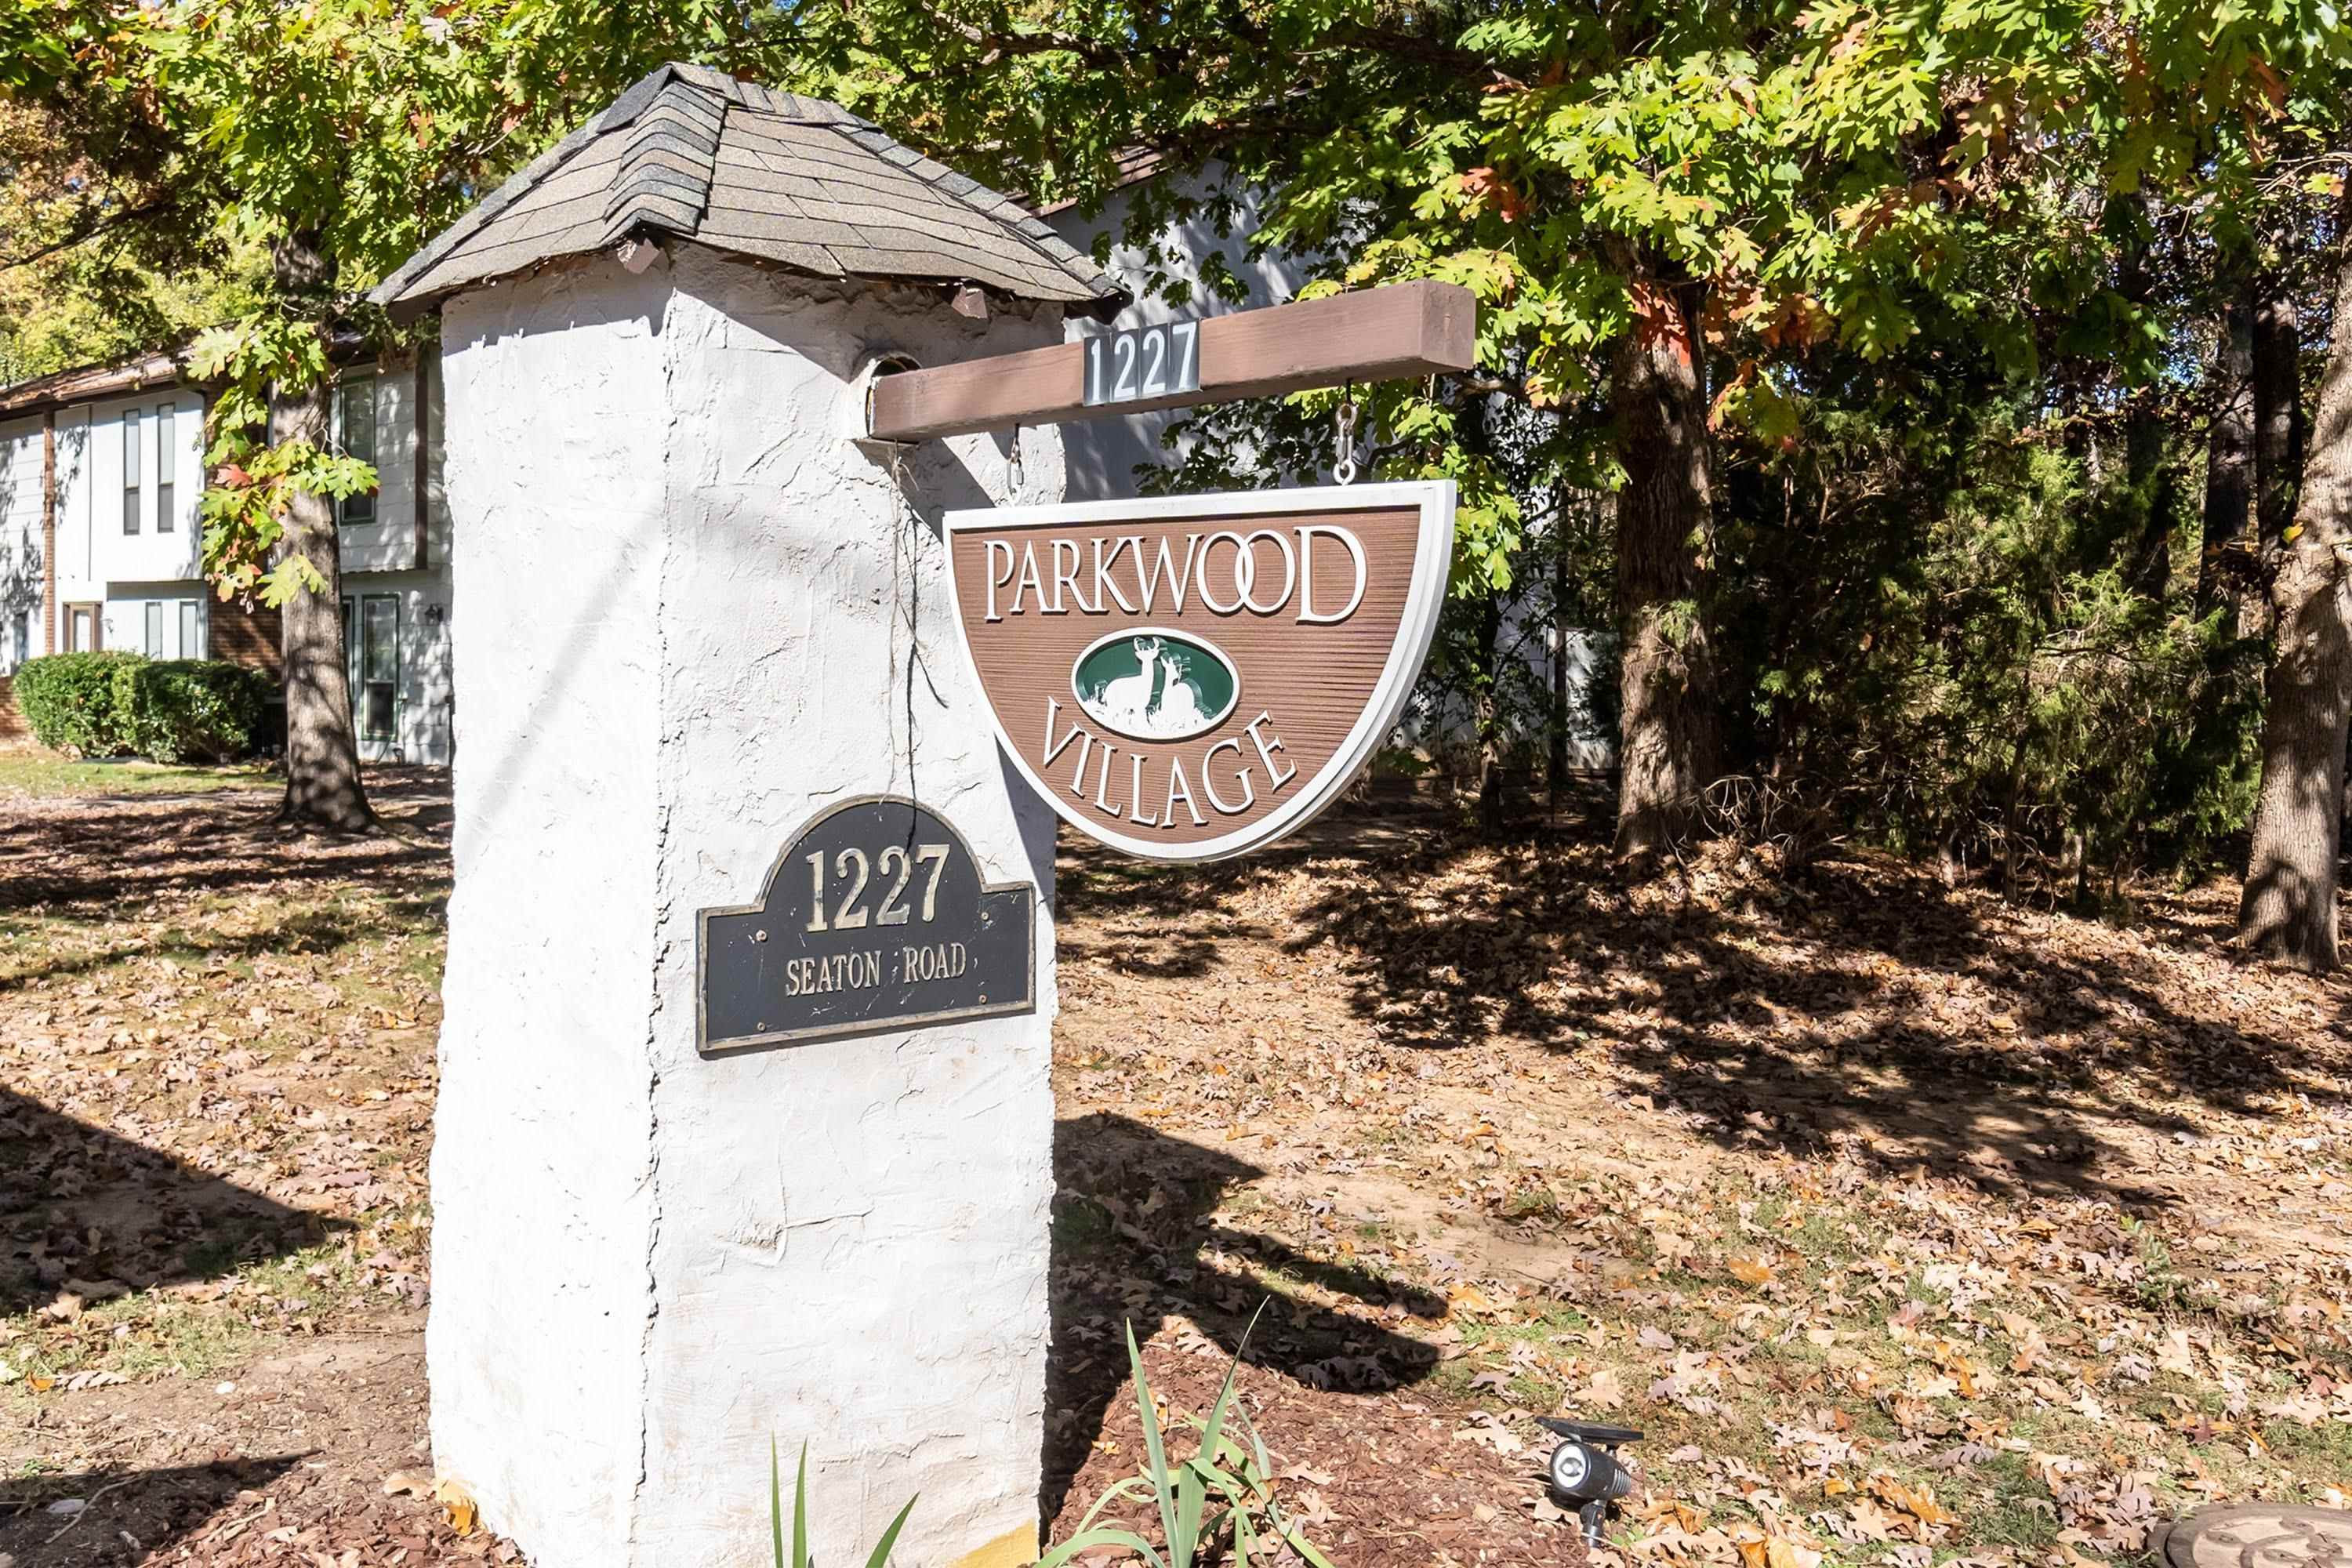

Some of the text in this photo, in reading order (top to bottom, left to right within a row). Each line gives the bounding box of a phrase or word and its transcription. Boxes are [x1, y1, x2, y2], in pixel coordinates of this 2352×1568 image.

[1091, 321, 1196, 402] 1227
[982, 524, 1367, 623] PARKWOOD
[1042, 695, 1298, 828] VILLAGE
[805, 844, 950, 932] 1227
[785, 942, 967, 997] SEATON ROAD
